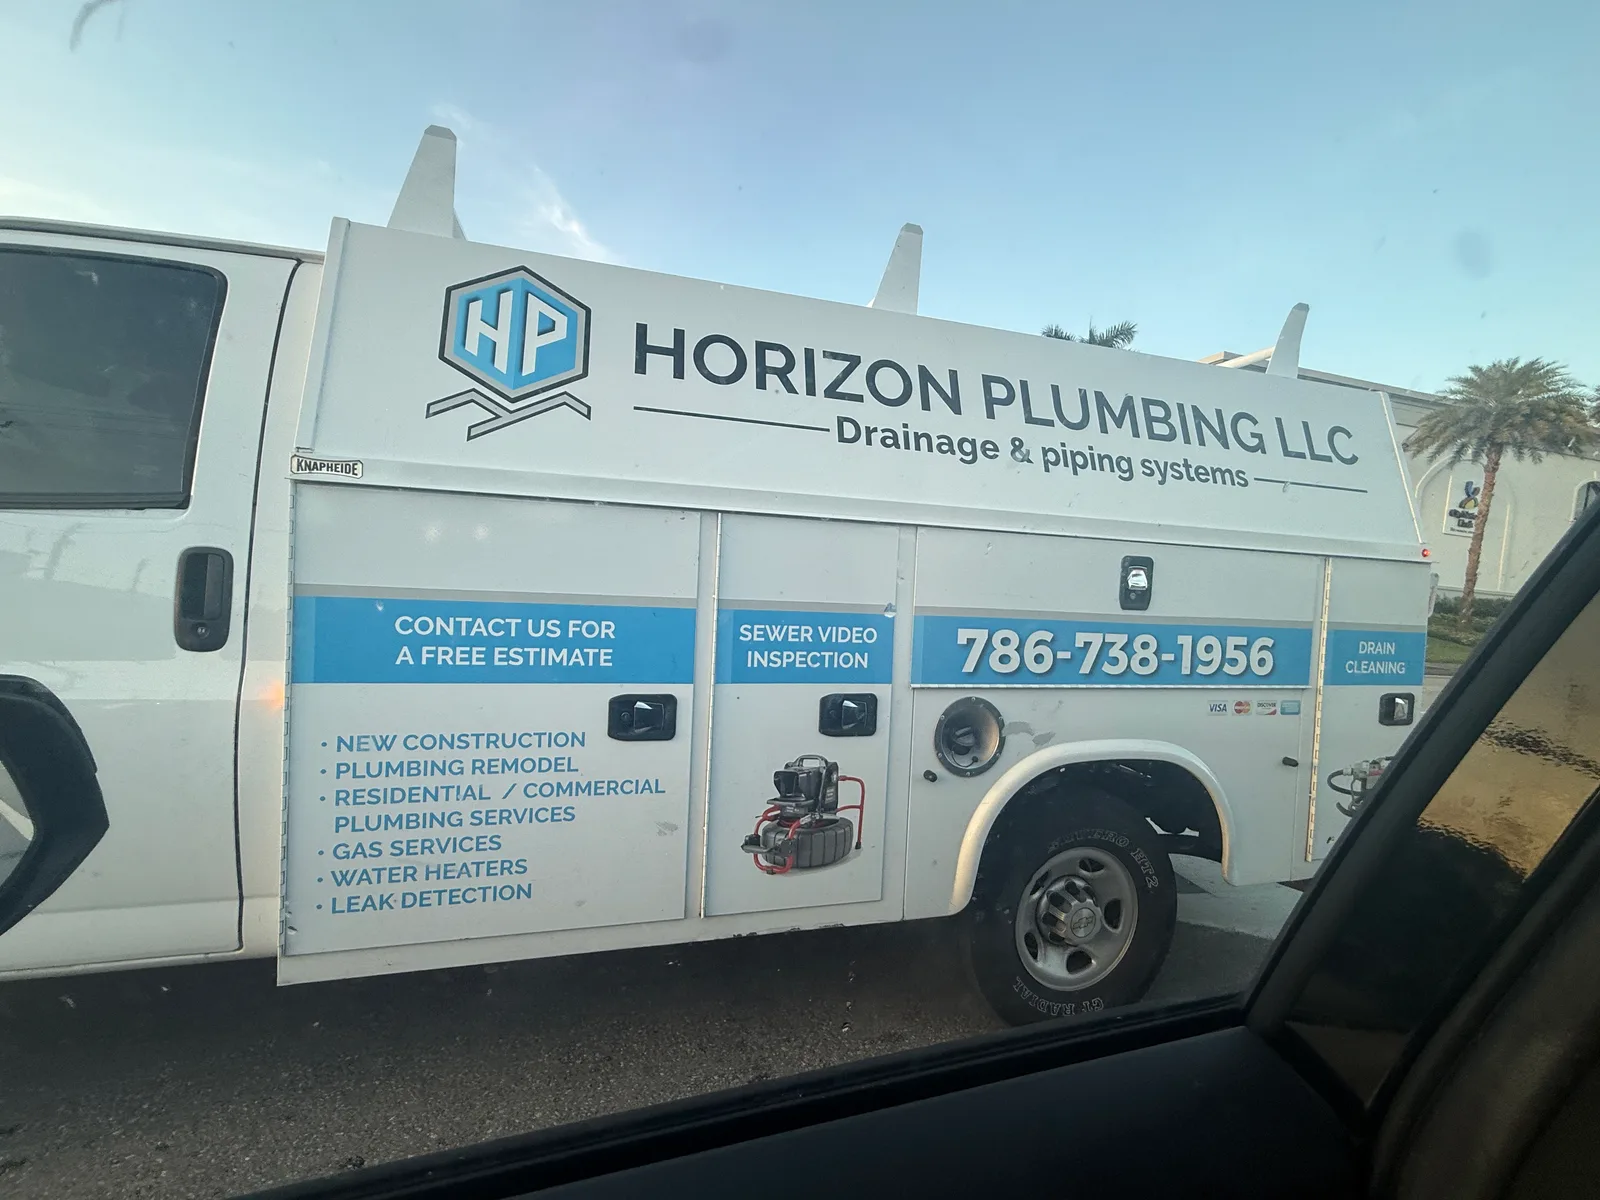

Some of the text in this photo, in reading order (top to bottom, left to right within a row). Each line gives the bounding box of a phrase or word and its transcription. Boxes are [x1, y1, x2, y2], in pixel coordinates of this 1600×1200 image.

[463, 289, 568, 376] HP
[633, 322, 1359, 466] HORIZON PLUMBING LLC
[835, 415, 1249, 488] Drainage & piping systems
[296, 459, 358, 475] KNAPHEIDE
[394, 615, 617, 640] CONTACT US FOR
[739, 624, 878, 644] SEWER VIDEO
[395, 645, 614, 668] A FREE ESTIMATE
[746, 650, 869, 670] INSPECTION
[957, 628, 1274, 676] 786-738-1956
[1358, 640, 1396, 656] DRAIN
[1345, 660, 1406, 675] CLEANING
[1208, 702, 1228, 713] VISA
[336, 731, 587, 754] NEW CONSTRUCTION
[335, 756, 580, 781] PLUMBING REMODEL
[334, 784, 493, 807] RESIDENTIAL
[522, 778, 666, 800] COMMERCIAL
[334, 805, 577, 835] PLUMBING SERVICES
[332, 834, 503, 862] GAS SERVICES
[330, 858, 529, 888] WATER HEATERS
[331, 883, 533, 916] LEAK DETECTION
[1012, 975, 1076, 1016] RADIAL
